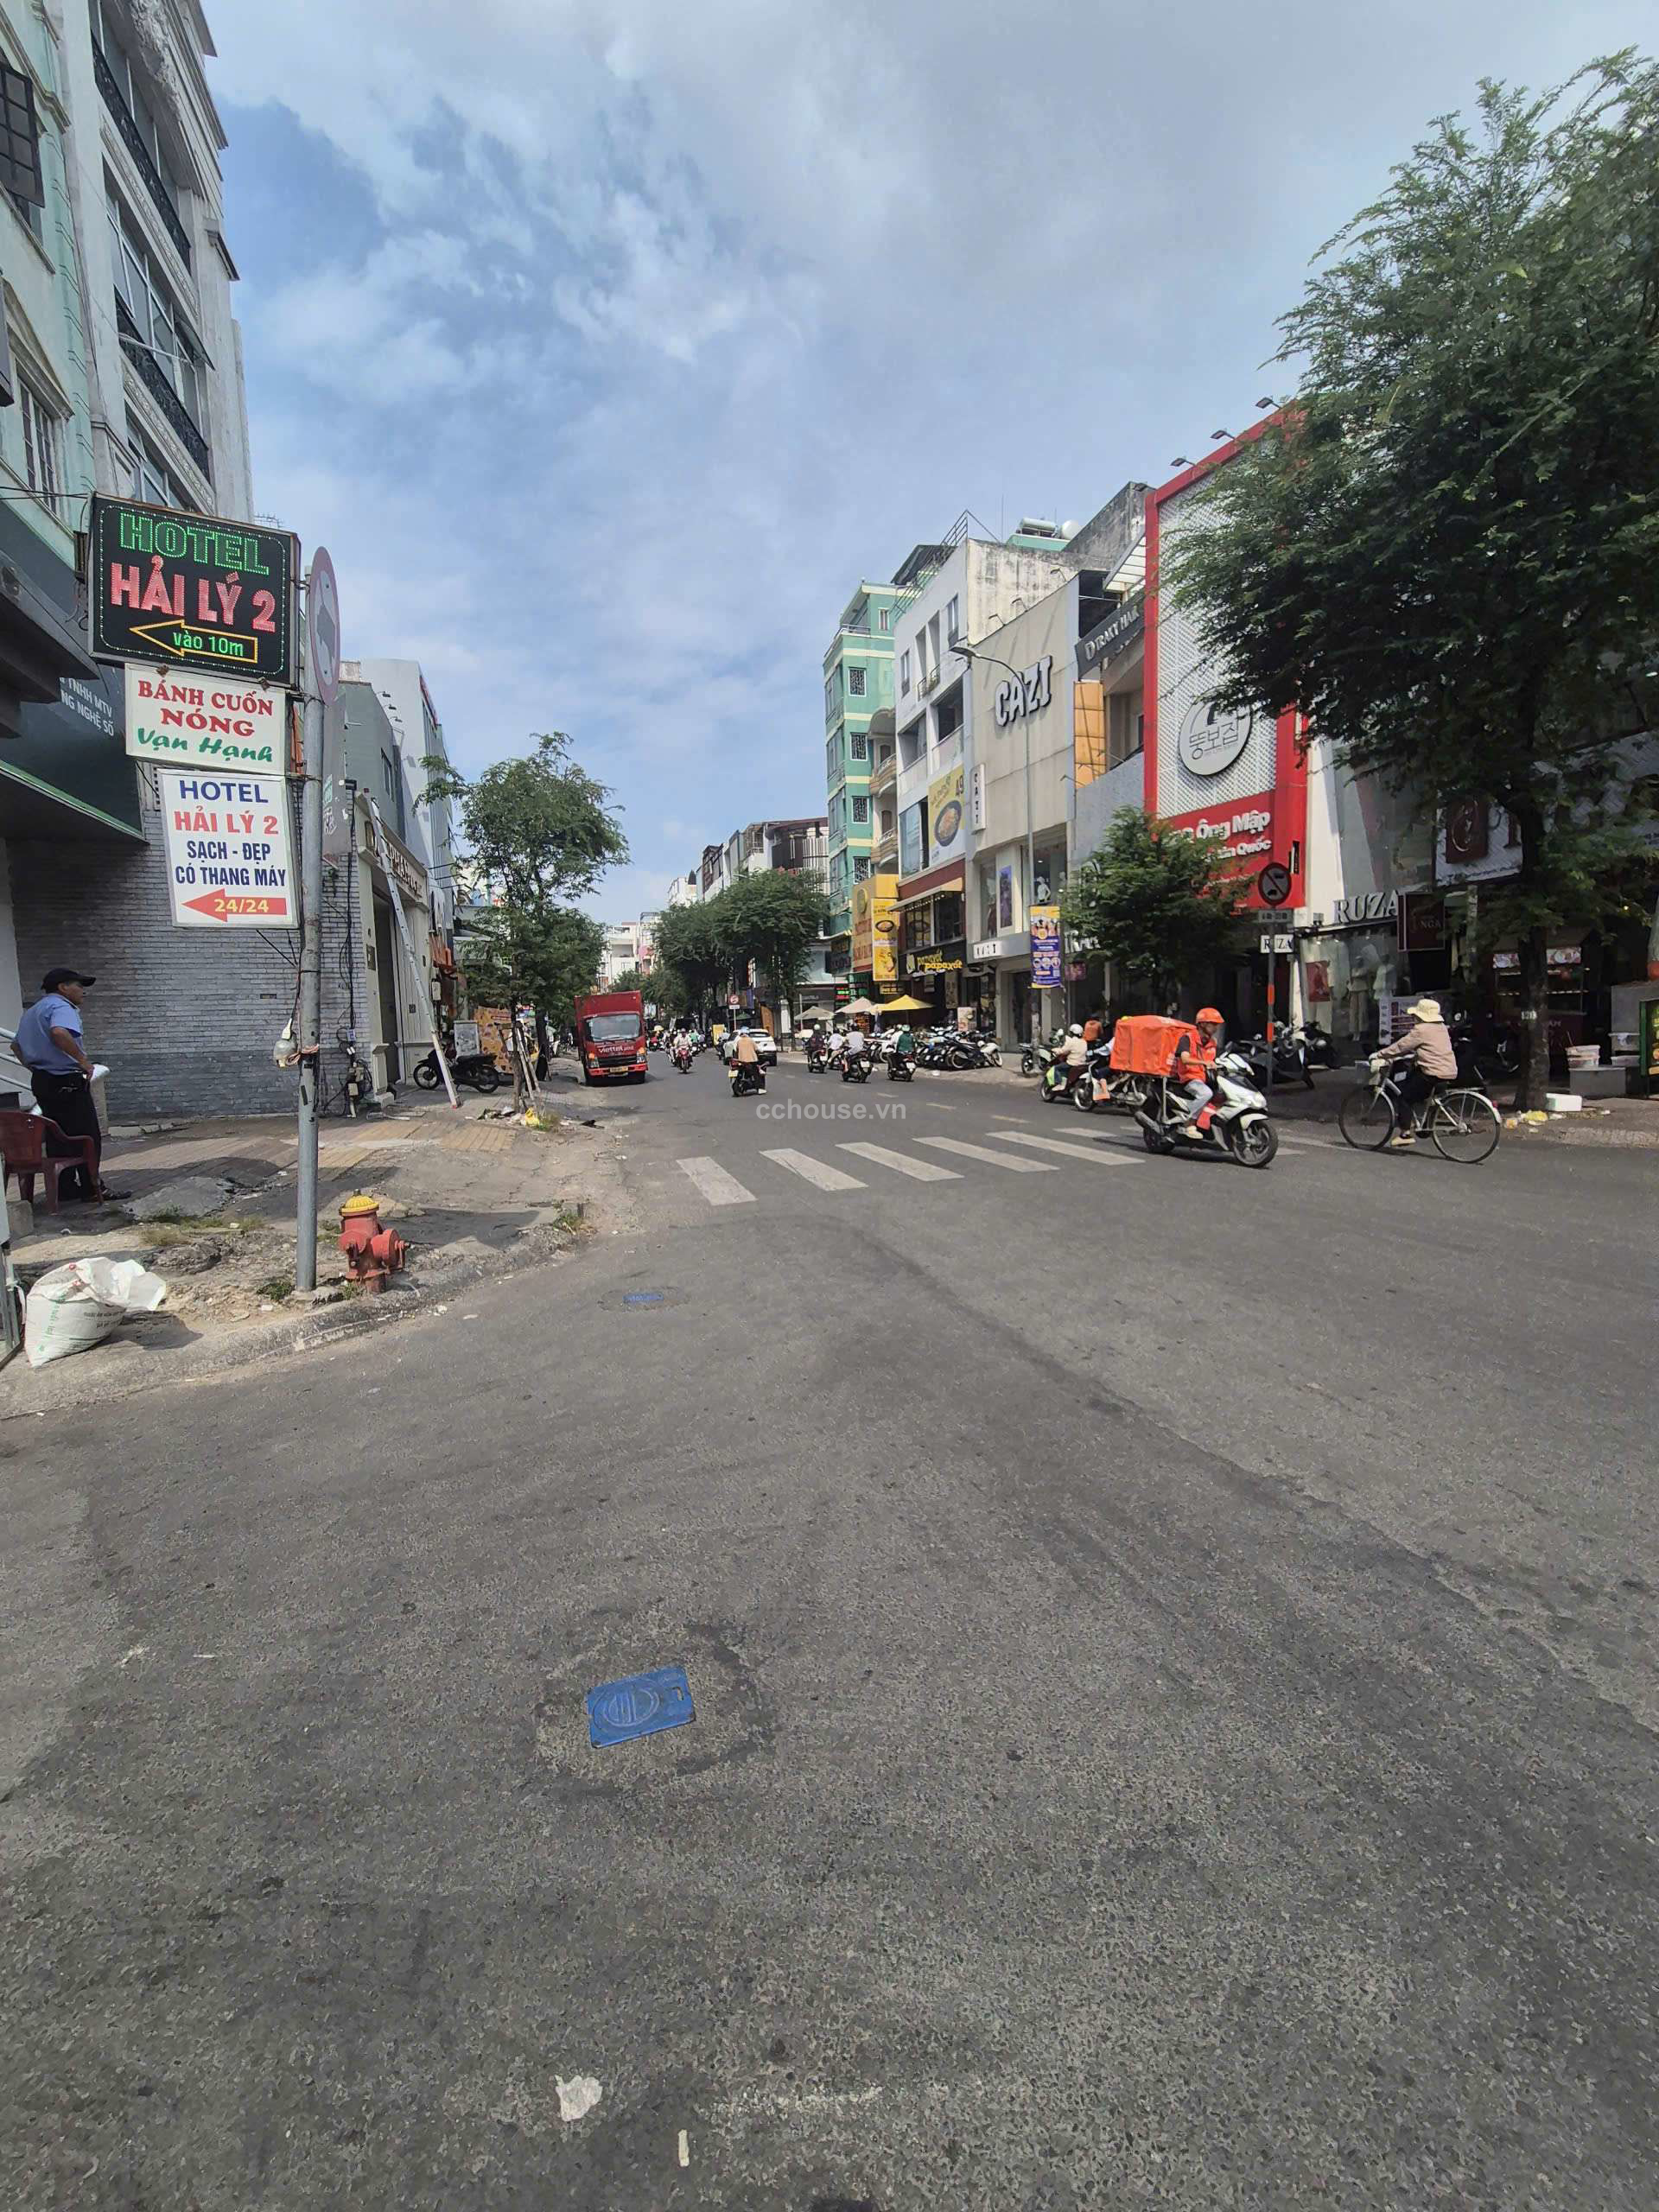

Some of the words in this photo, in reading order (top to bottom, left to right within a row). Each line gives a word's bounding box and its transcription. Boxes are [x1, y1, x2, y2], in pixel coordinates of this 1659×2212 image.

[119, 512, 270, 575] HOTEL
[110, 556, 185, 616] HẢI
[198, 571, 243, 626] LÝ
[252, 589, 276, 632] 2
[173, 630, 202, 649] vào
[208, 635, 244, 657] 10m
[60, 690, 75, 710] NG
[137, 673, 205, 706] BÁNH
[995, 656, 1052, 727] CAZI
[160, 708, 255, 737] NÓNG
[137, 728, 188, 751] Vạn
[199, 737, 273, 762] Hạnh
[179, 779, 269, 804] HOTEL
[174, 805, 218, 833] HẢI
[226, 810, 255, 834] LÝ
[263, 815, 279, 835] 2
[187, 840, 227, 862] SẠCH
[242, 842, 271, 865] ĐẸP
[175, 862, 196, 885] CÓ
[200, 867, 250, 887] THANG
[254, 865, 286, 887] MÁY
[213, 898, 270, 913] 24/24
[1333, 889, 1398, 924] RUZA
[1264, 938, 1294, 950] RZA
